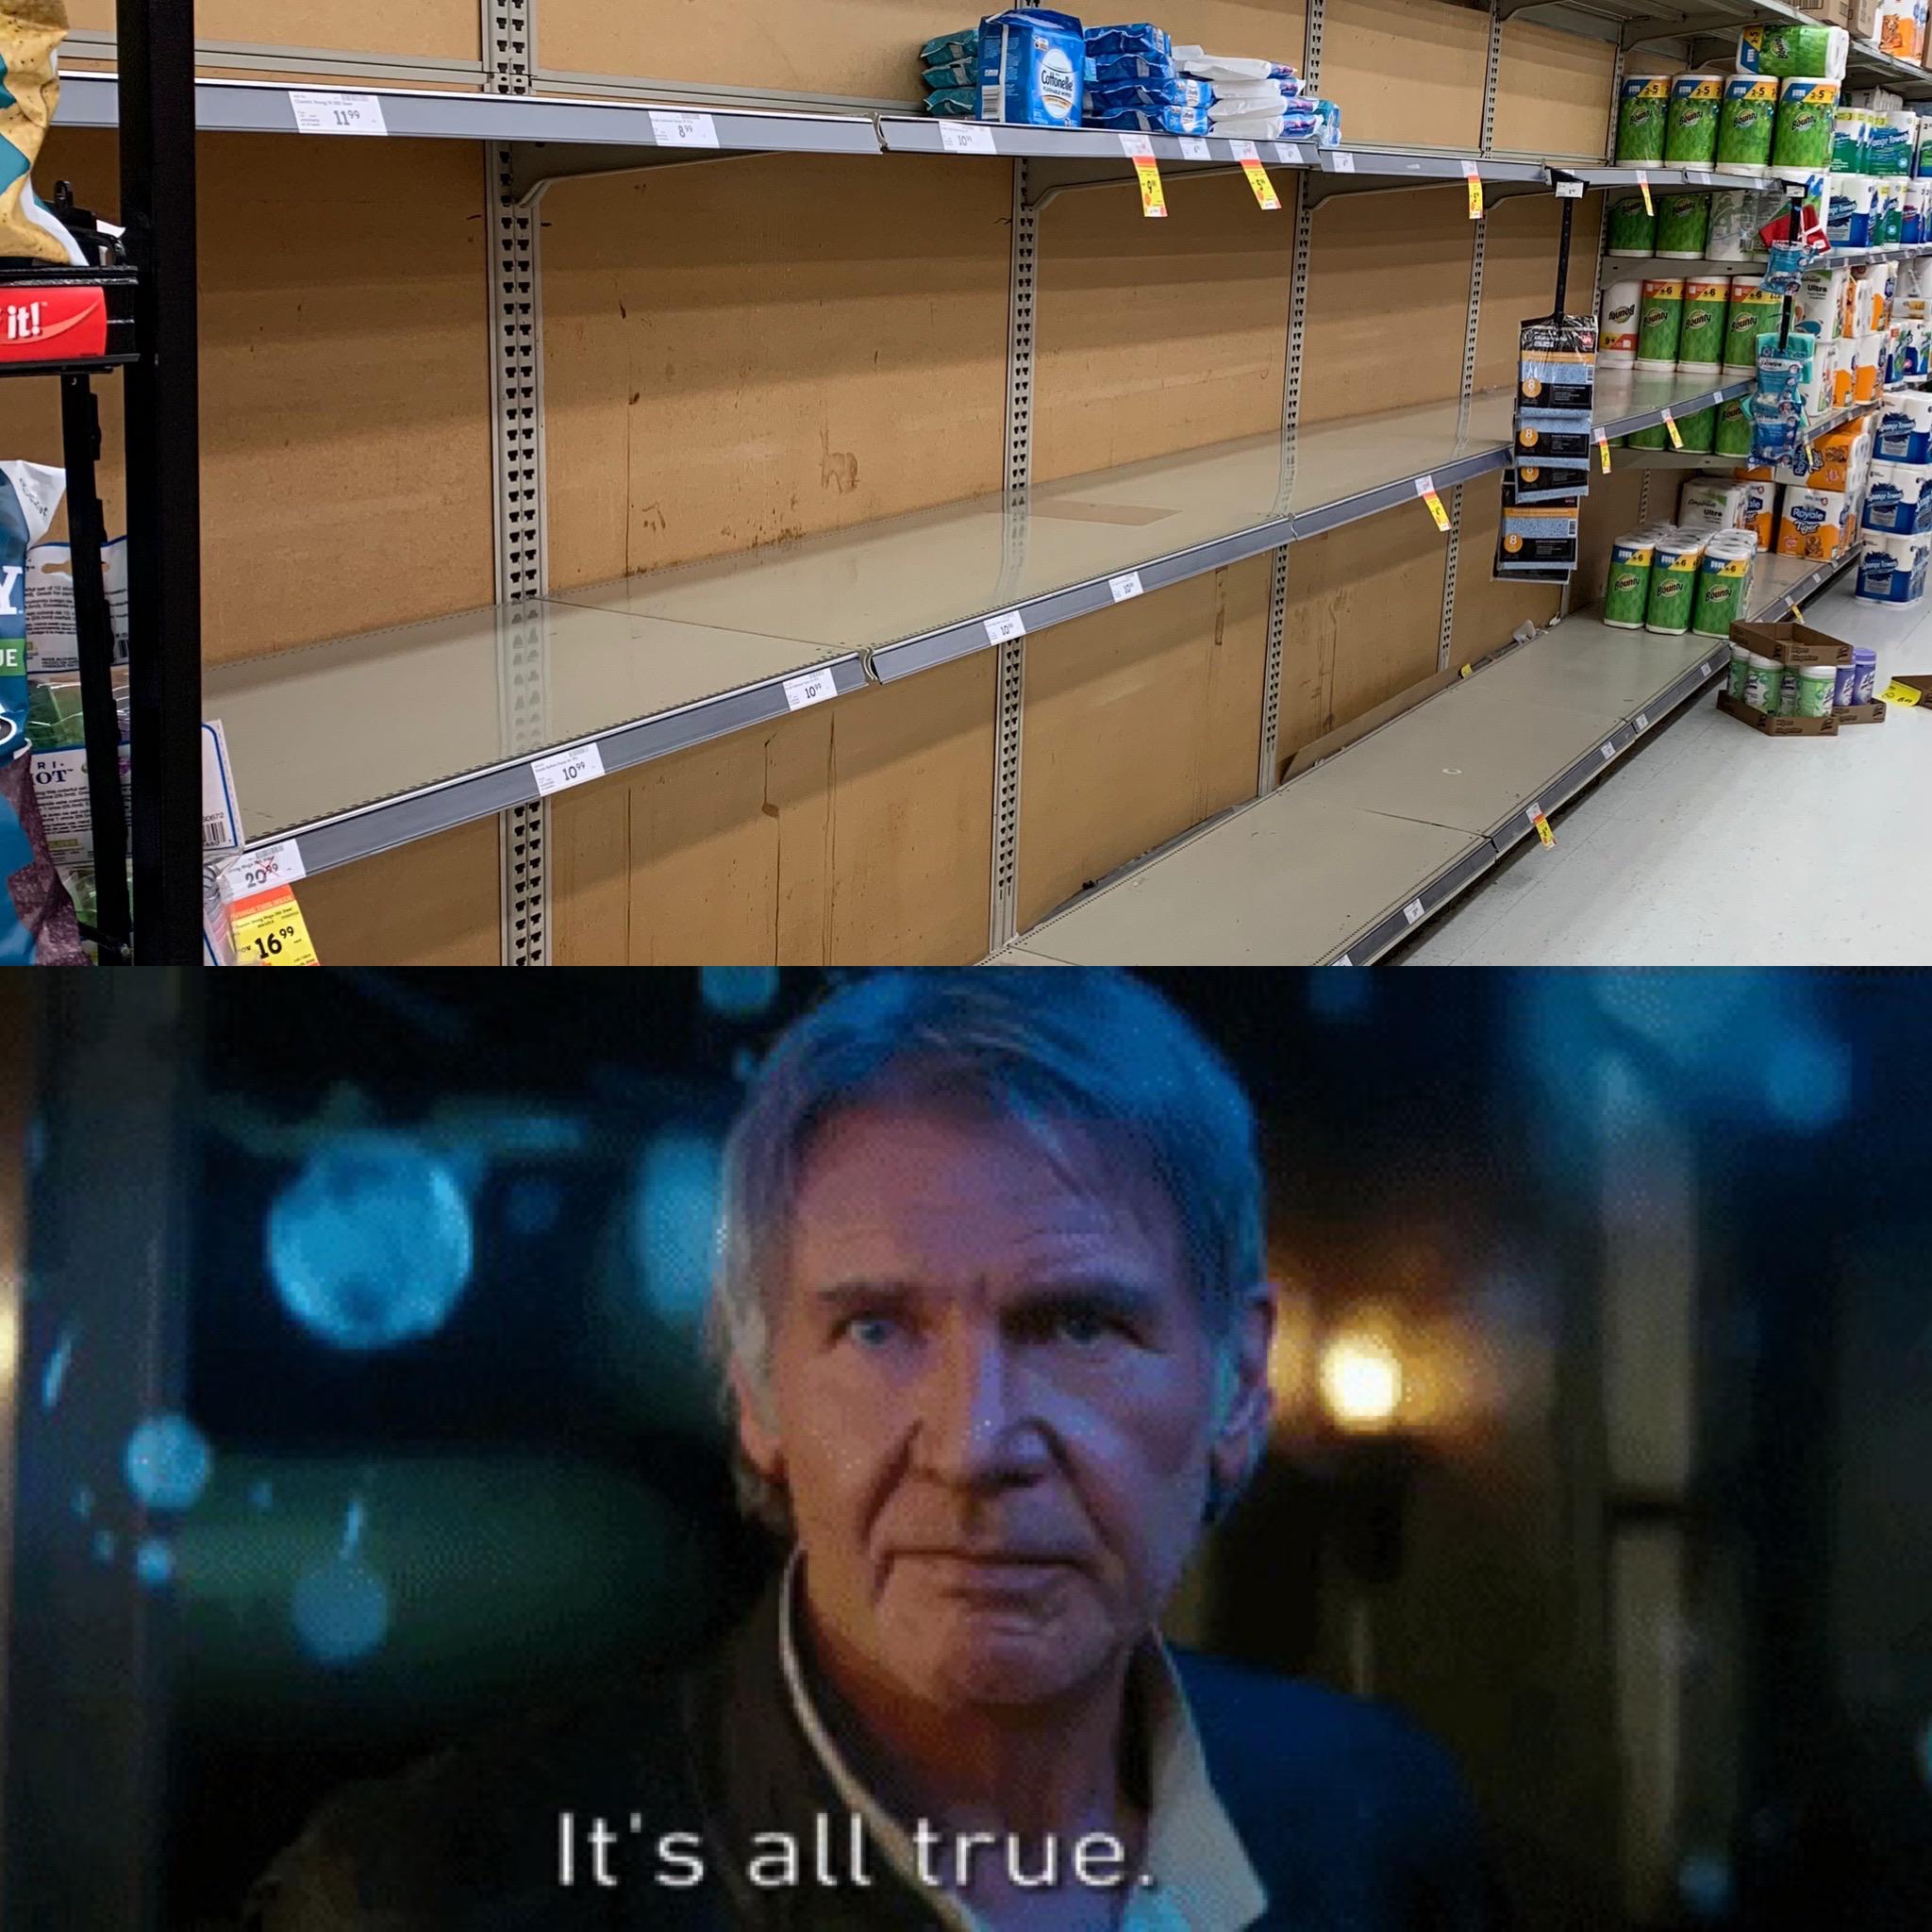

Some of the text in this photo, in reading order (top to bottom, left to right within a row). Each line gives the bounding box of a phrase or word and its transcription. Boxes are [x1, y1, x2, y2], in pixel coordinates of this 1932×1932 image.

[1041, 70, 1074, 92] Cottonelle
[1807, 284, 1827, 293] Ultra
[8, 302, 41, 340] it!
[1643, 311, 1669, 328] Bounty
[1685, 313, 1712, 330] Bounty
[1730, 315, 1757, 332] Bounty
[1722, 406, 1743, 422] Boun
[1703, 508, 1724, 518] Ultra
[1792, 507, 1824, 521] Royale
[1794, 520, 1820, 535] Tiger
[1614, 576, 1641, 591] Bounty
[1656, 582, 1684, 597] Bounty
[1705, 588, 1733, 603] Bounty
[255, 925, 294, 959] 1699
